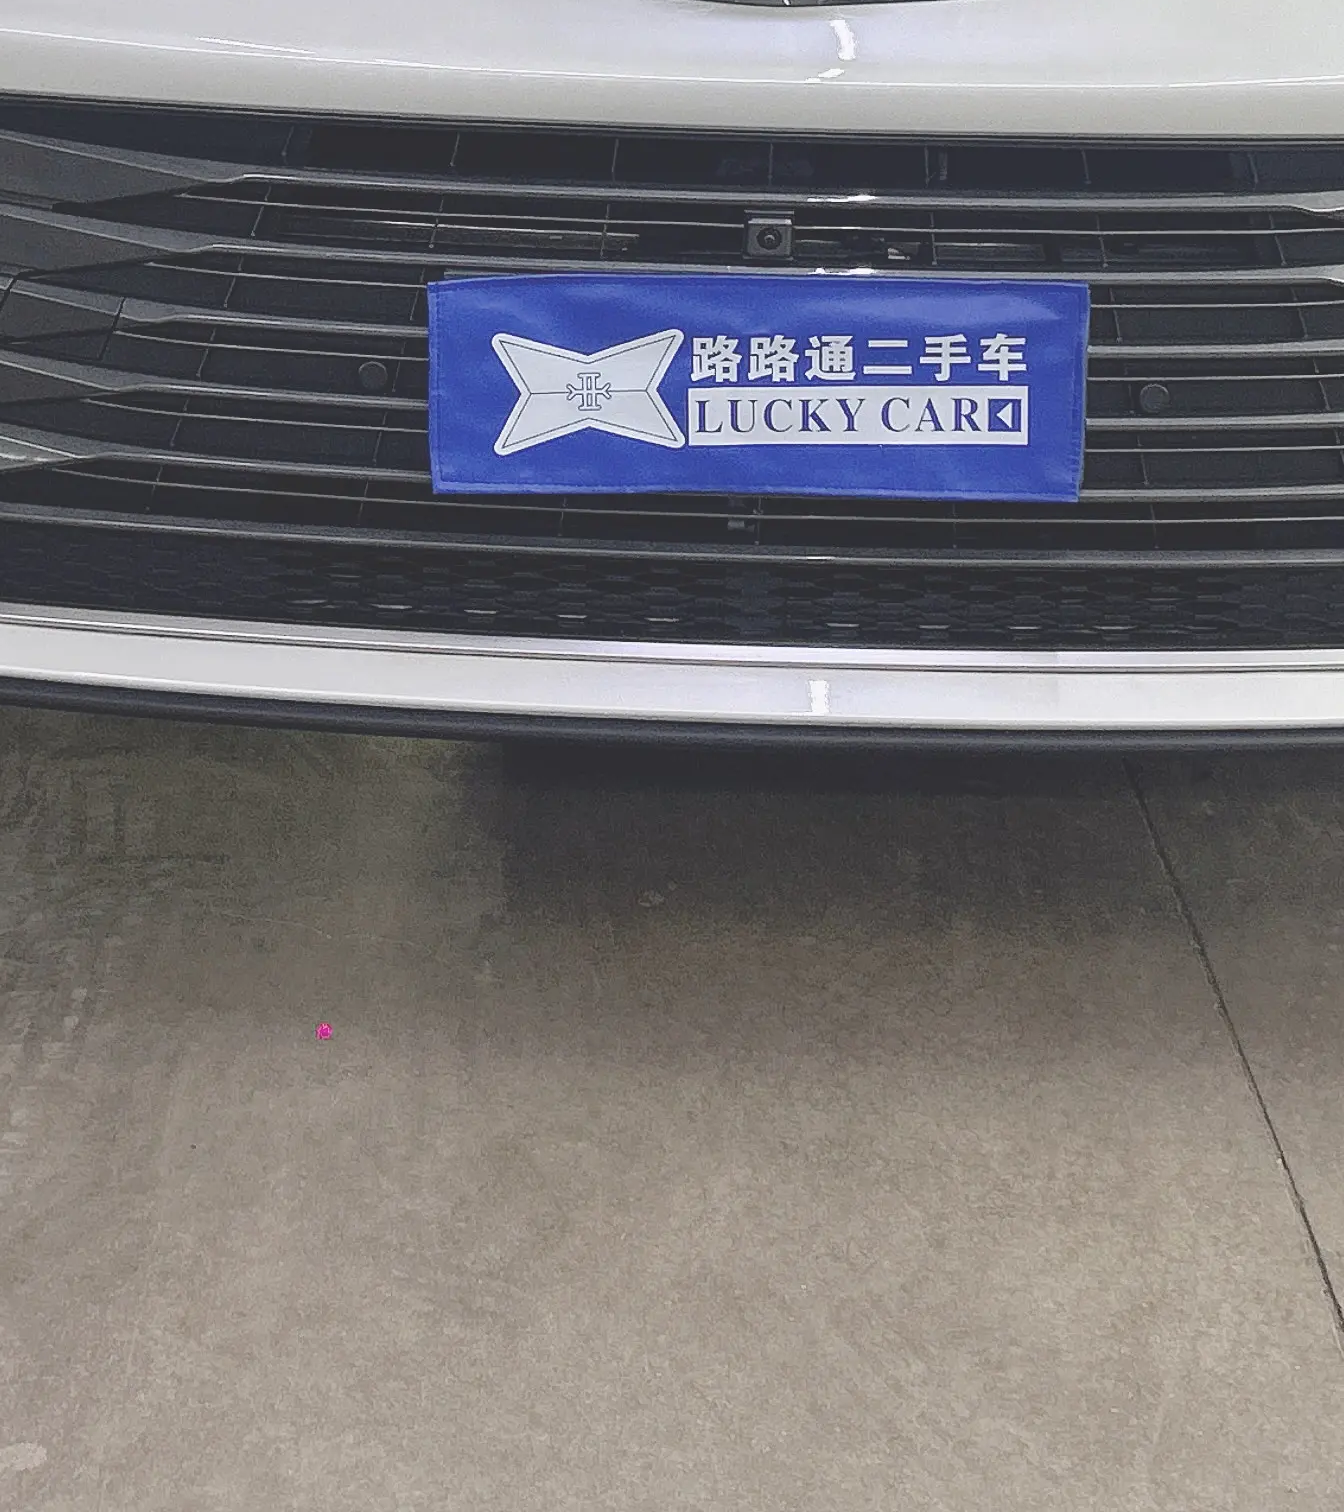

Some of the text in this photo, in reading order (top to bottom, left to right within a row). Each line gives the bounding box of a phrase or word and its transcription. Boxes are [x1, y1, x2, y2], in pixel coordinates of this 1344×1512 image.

[690, 333, 1027, 383] 路路通二手车
[693, 396, 979, 435] LUCKY CAR
